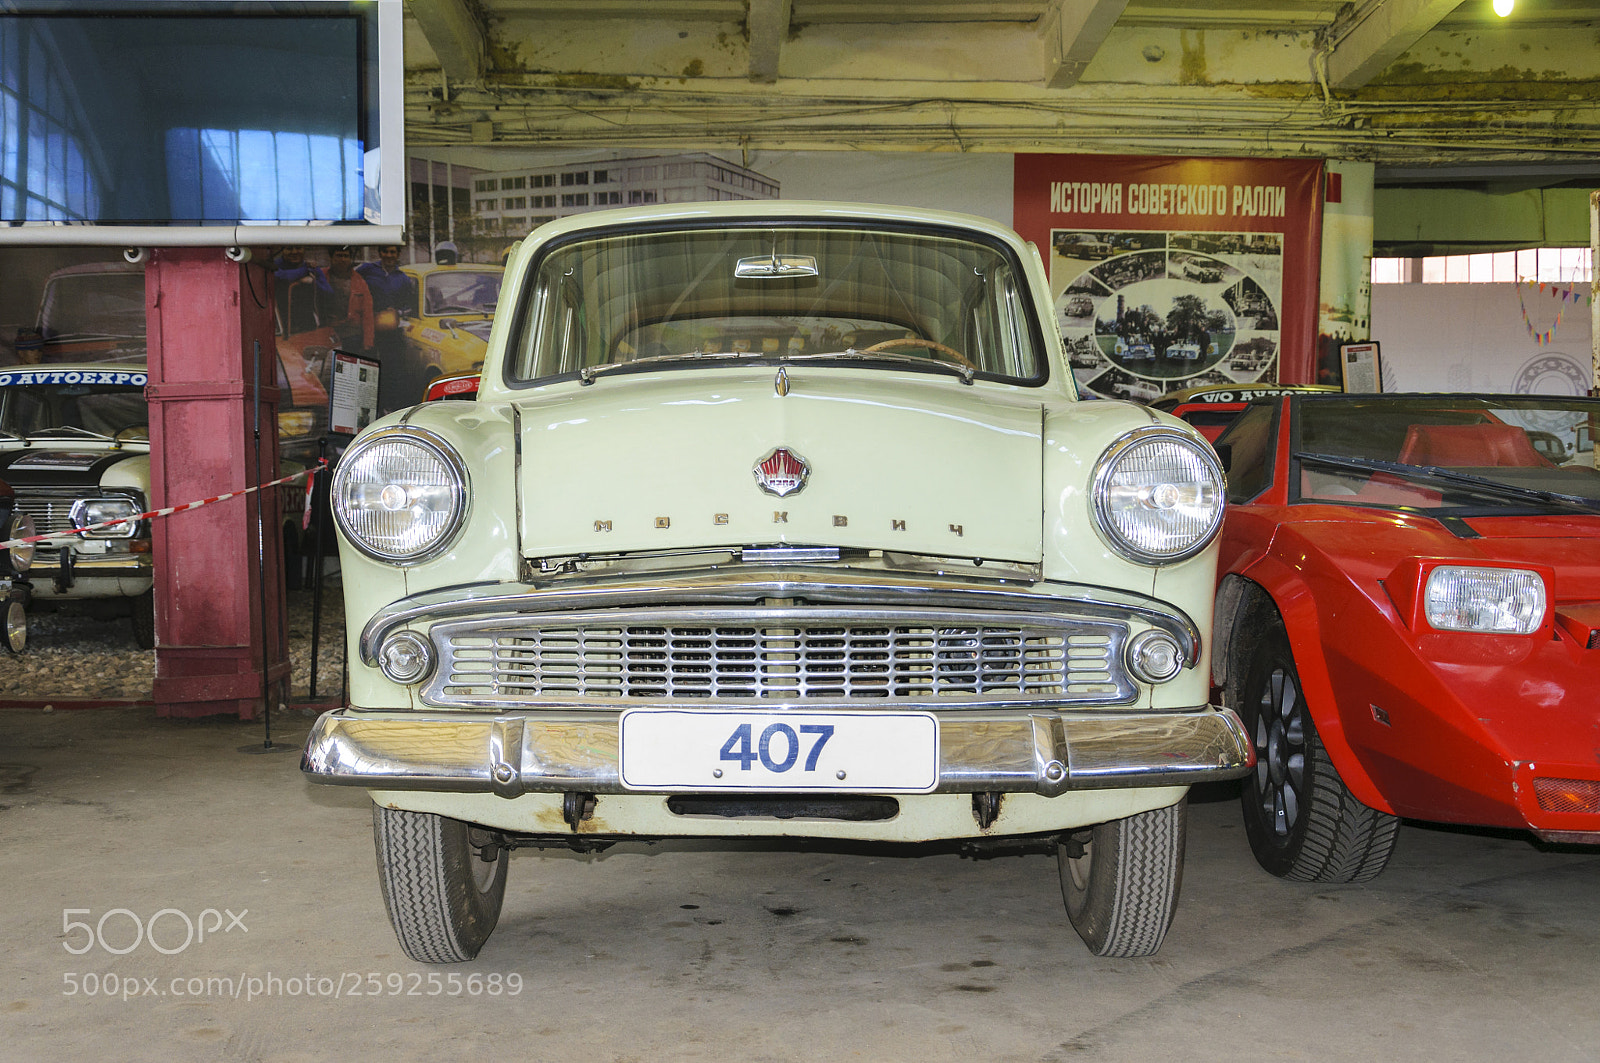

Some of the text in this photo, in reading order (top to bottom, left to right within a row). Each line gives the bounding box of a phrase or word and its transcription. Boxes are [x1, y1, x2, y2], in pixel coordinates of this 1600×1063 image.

[1050, 182, 1286, 217] ИСТОРИЯ СОВЕТСКОГО РАЛЛИ
[16, 372, 147, 386] AVTOEXPO
[1202, 392, 1234, 403] V/O
[720, 722, 835, 773] 407
